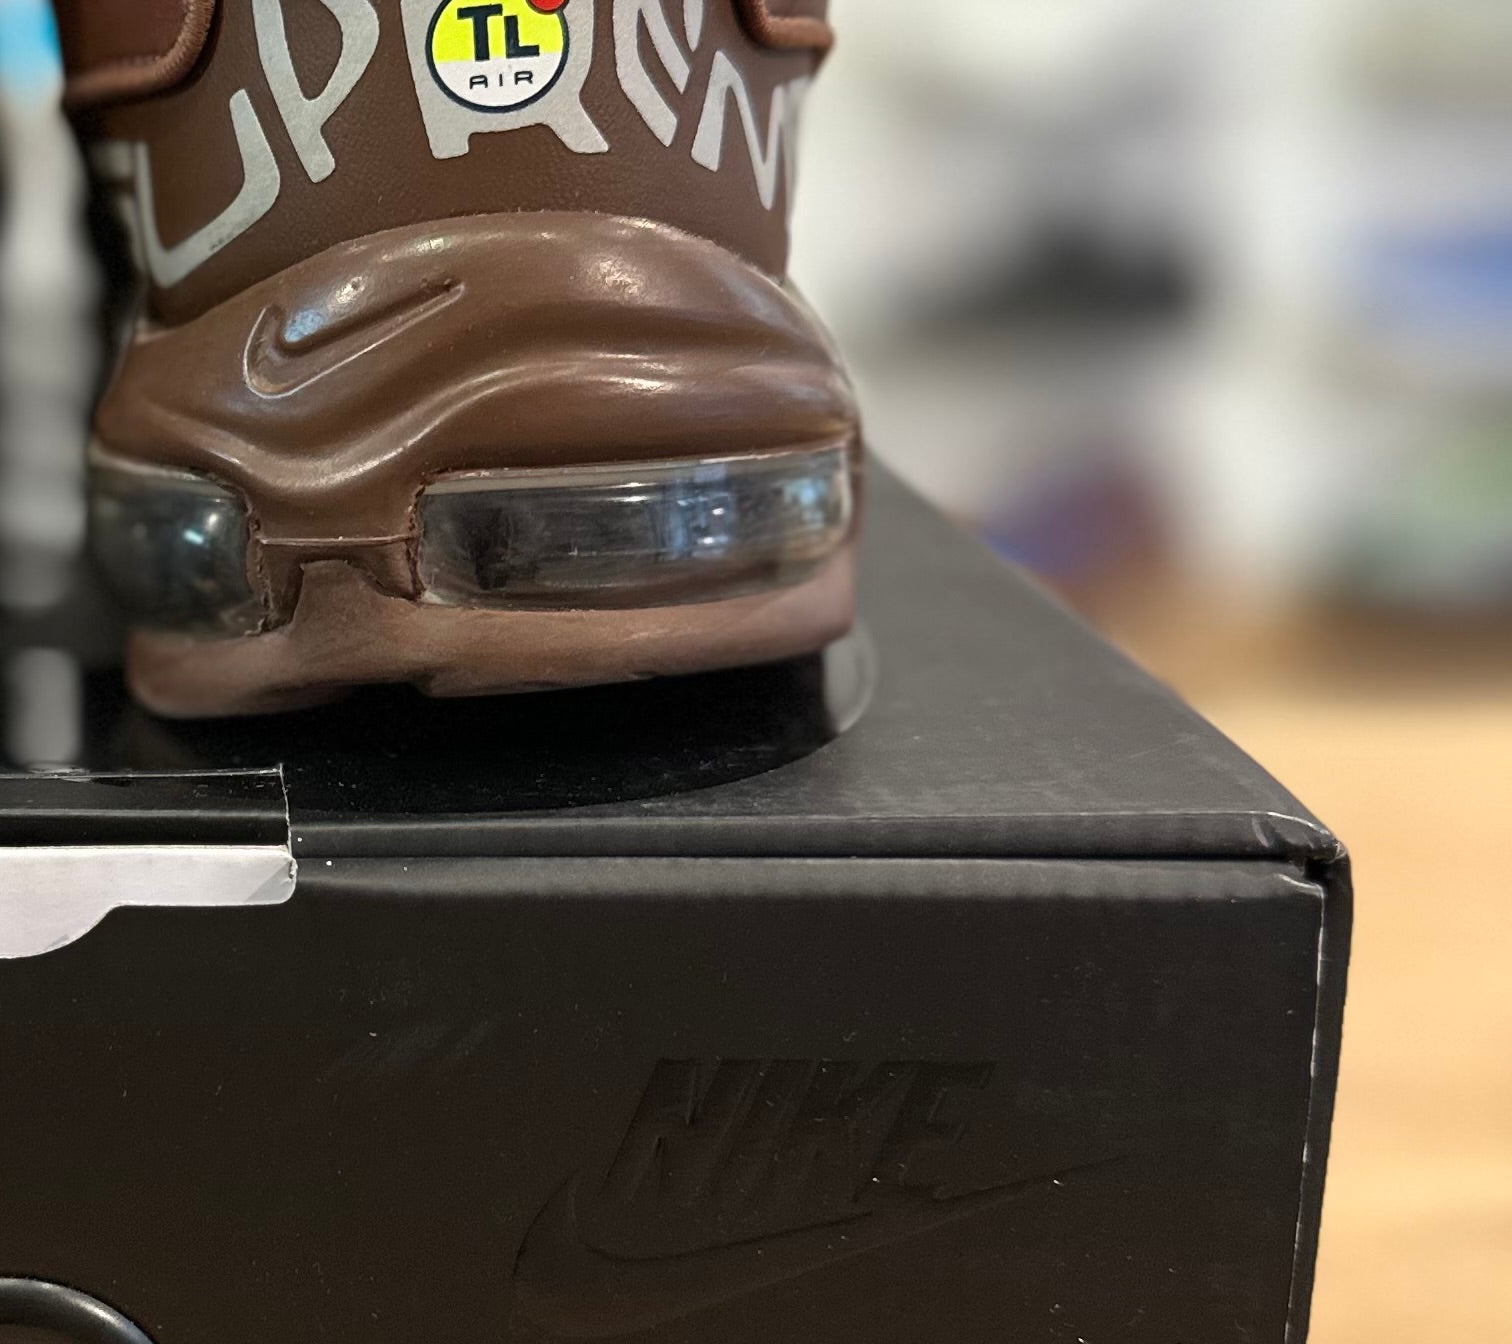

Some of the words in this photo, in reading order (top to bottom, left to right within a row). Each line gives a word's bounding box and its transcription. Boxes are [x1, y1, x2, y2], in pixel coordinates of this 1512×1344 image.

[456, 3, 540, 62] TL
[469, 70, 534, 89] AIR
[591, 1055, 998, 1204] NIKE
